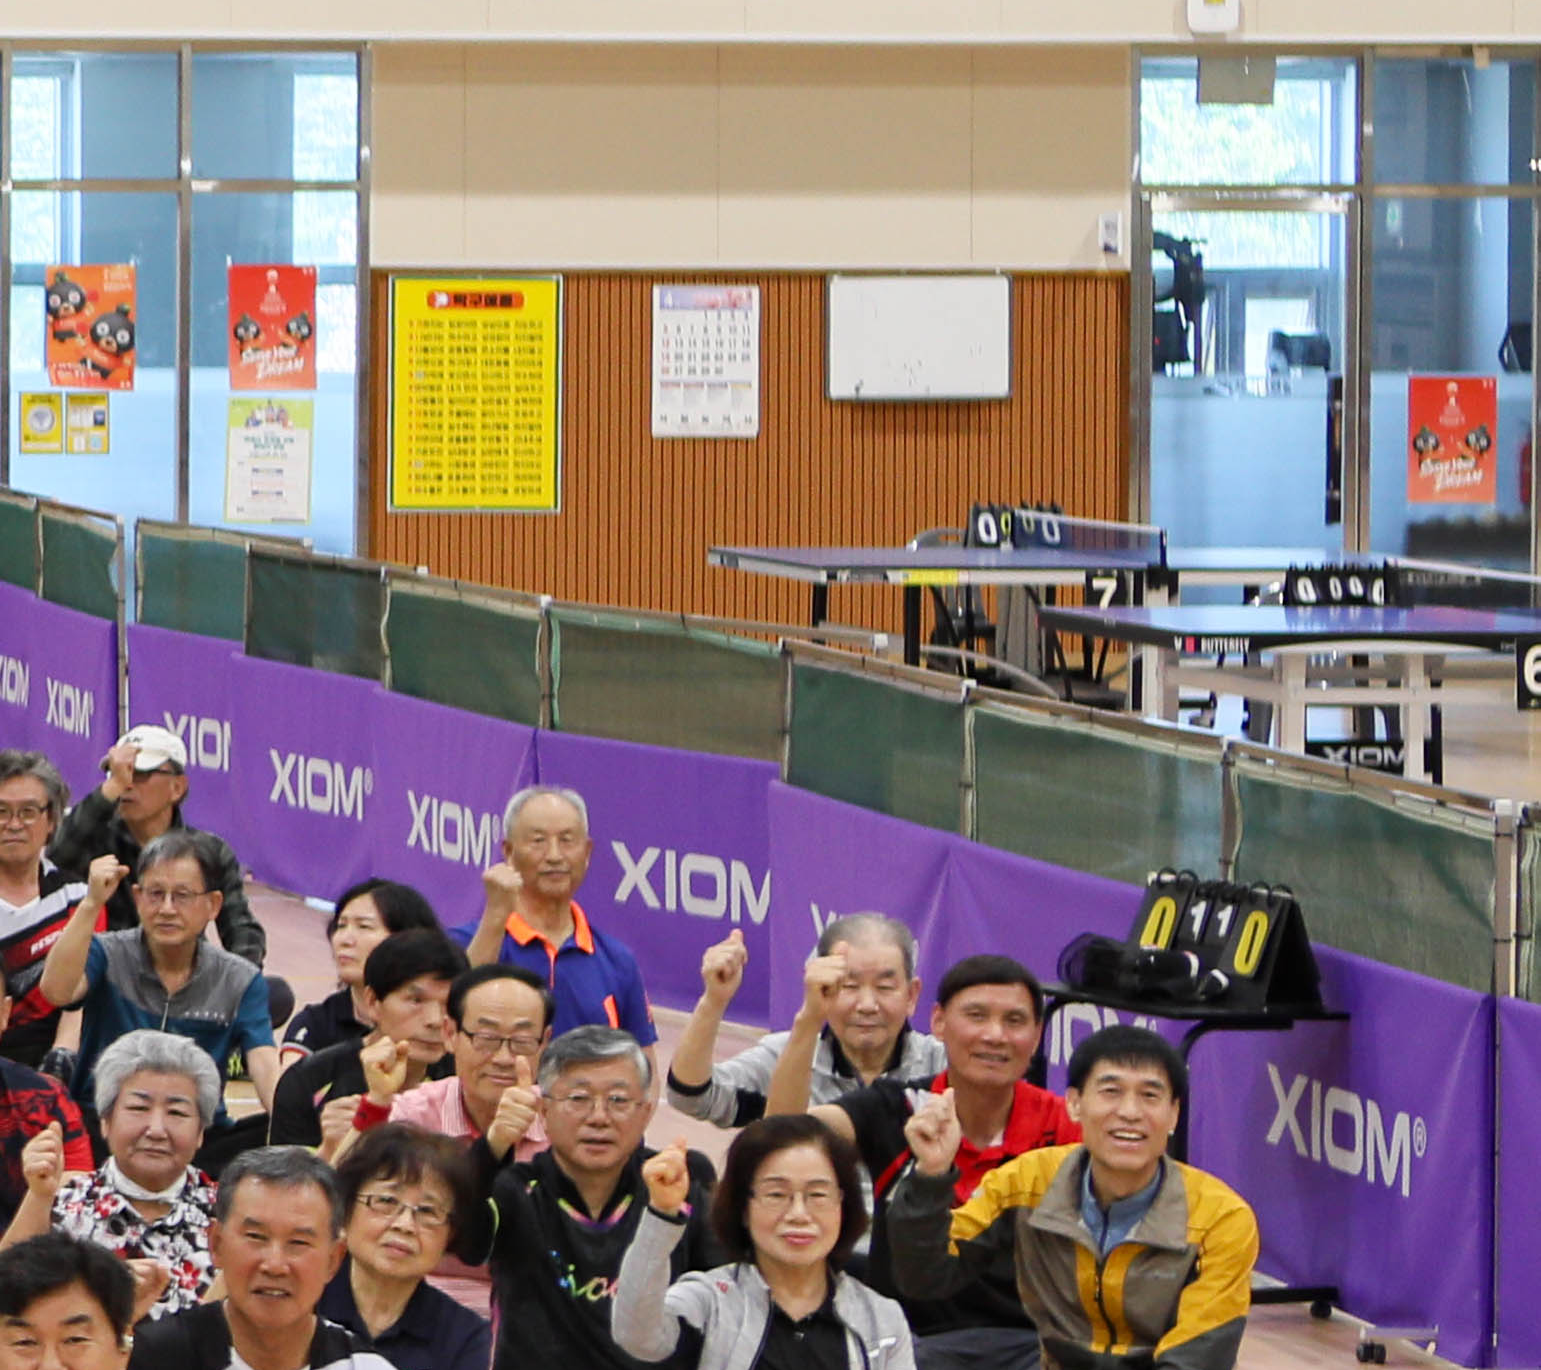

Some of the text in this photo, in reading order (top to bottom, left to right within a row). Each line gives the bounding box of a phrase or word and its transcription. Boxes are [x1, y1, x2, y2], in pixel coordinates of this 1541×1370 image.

[1092, 577, 1118, 609] 7
[1191, 900, 1208, 942] 1
[1217, 903, 1234, 938] 1
[1234, 911, 1269, 975] 0
